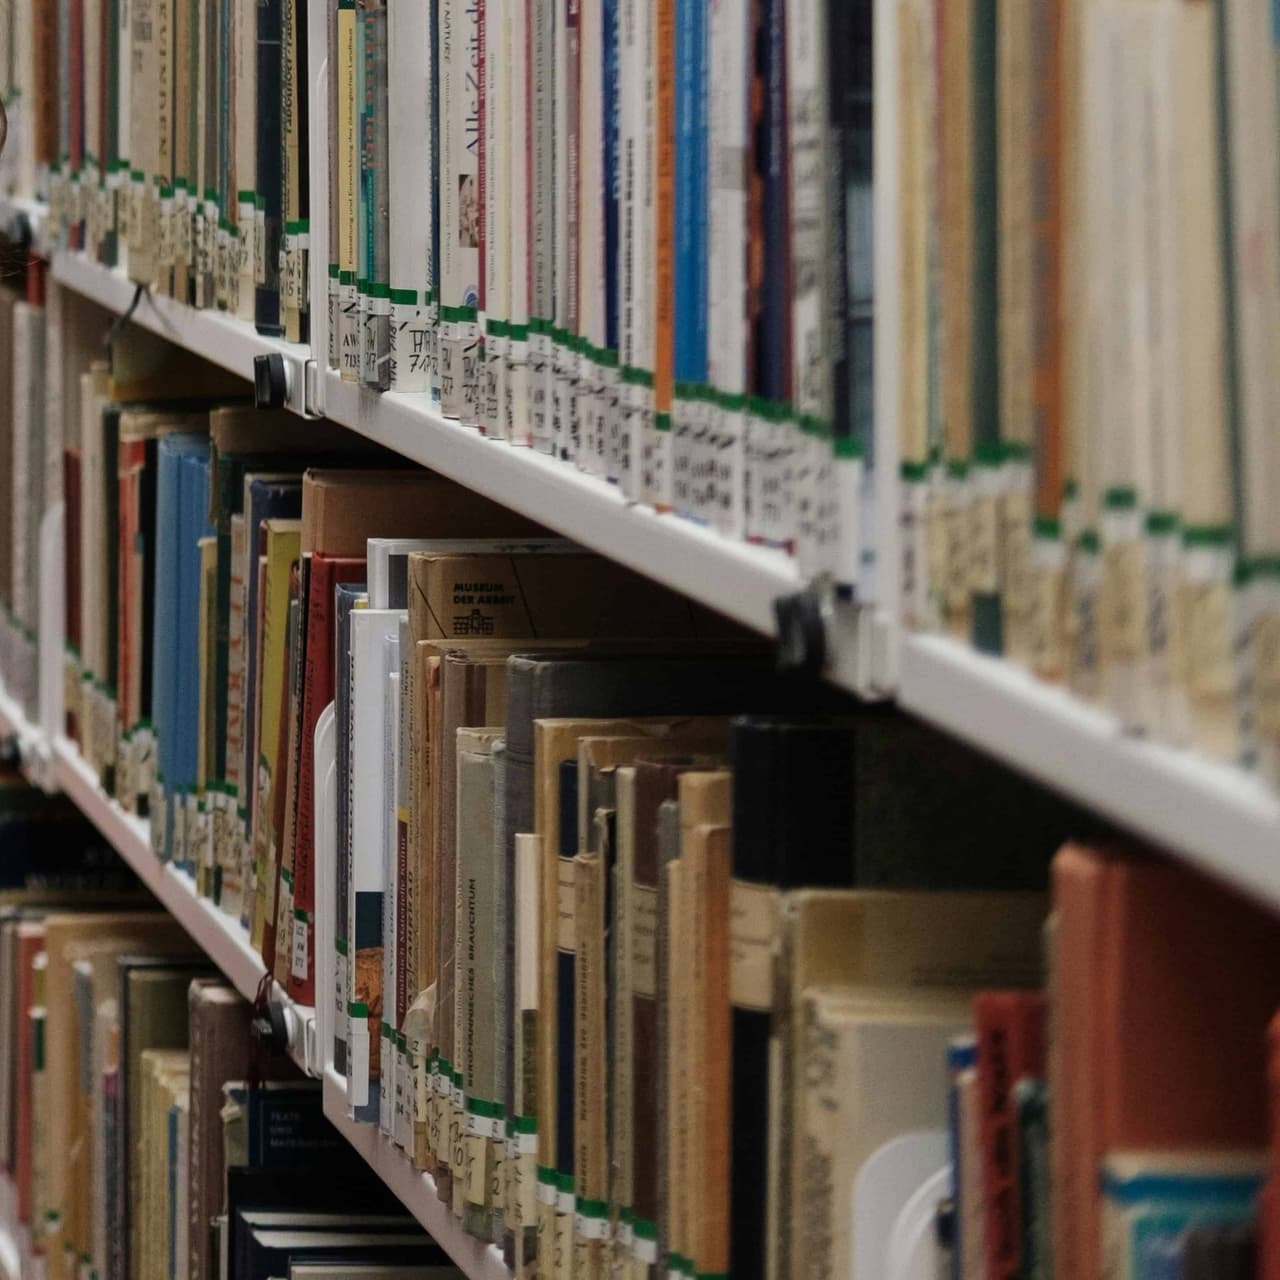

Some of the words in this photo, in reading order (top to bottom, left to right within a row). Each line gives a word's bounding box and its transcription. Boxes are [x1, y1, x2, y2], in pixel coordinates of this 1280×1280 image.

[443, 9, 452, 63] NATURE
[464, 38, 479, 93] Zeit
[464, 101, 479, 157] Alle
[453, 583, 505, 593] MUSEUM
[453, 595, 475, 605] DER
[478, 595, 515, 605] ARBEIT
[467, 877, 477, 962] BRAUCHTUM
